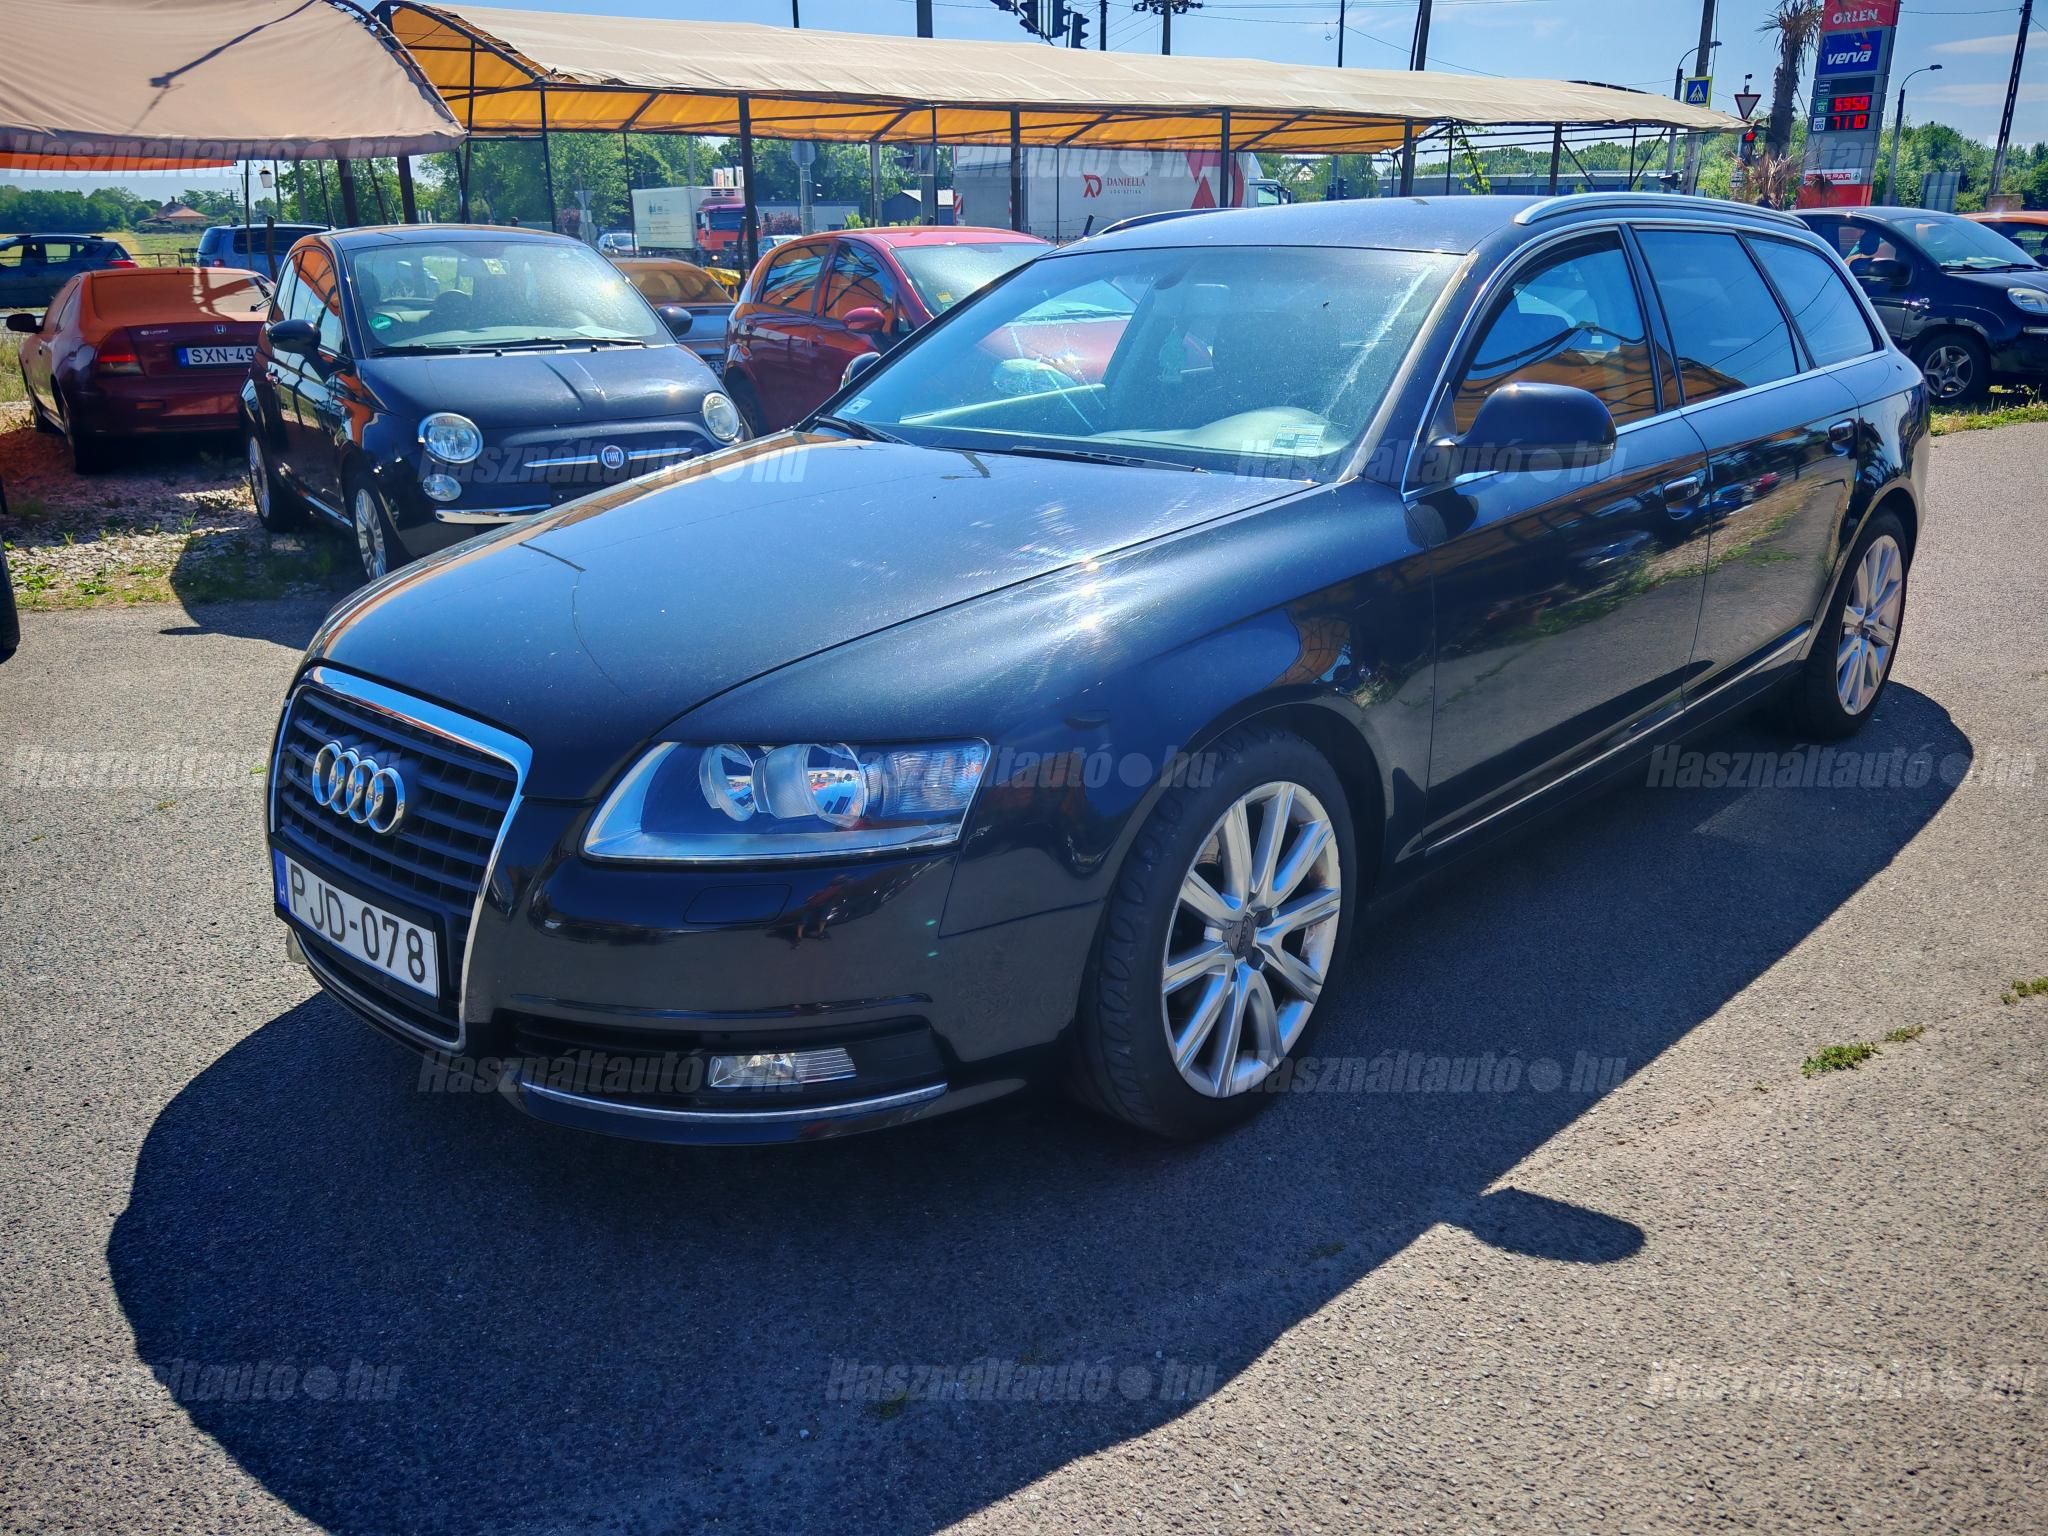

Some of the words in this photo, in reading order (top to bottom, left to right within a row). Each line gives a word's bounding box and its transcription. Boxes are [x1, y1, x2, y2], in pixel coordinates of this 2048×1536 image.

[1832, 8, 1878, 24] ORLEN
[1826, 50, 1872, 65] verva
[1107, 177, 1146, 187] DANIELLA
[191, 348, 255, 363] SXN-49
[279, 887, 287, 901] H
[290, 863, 426, 984] PJD-078
